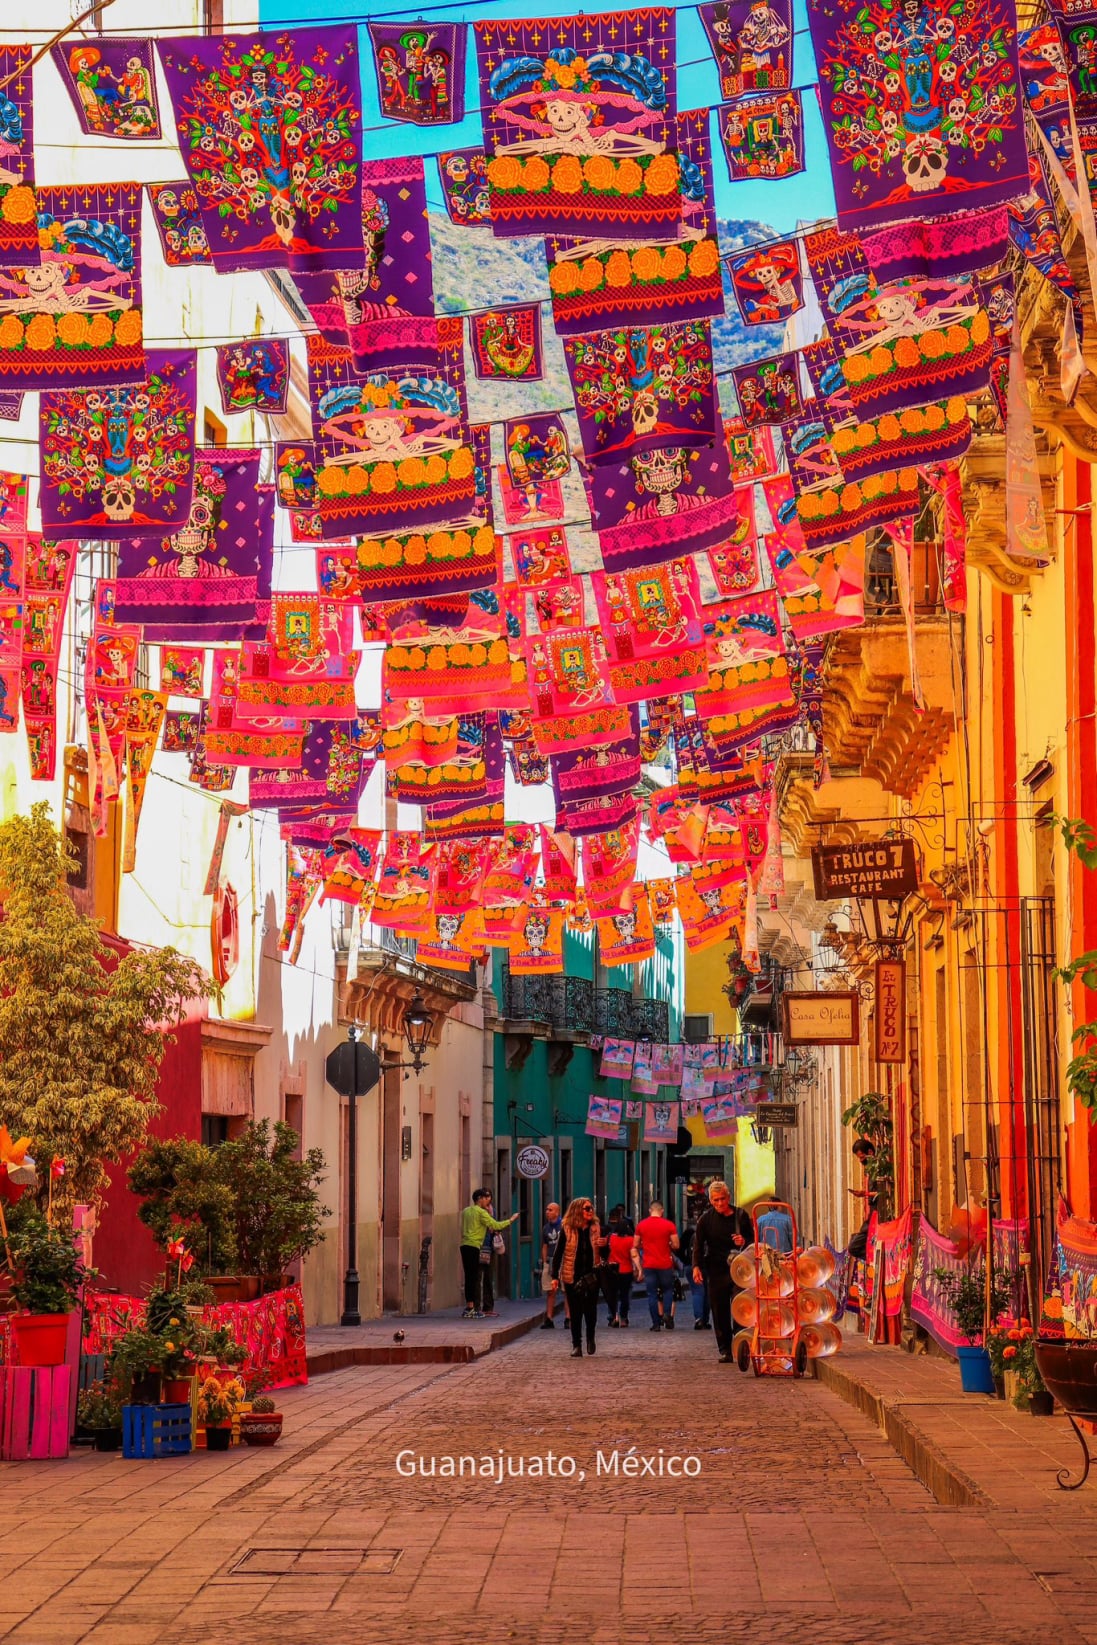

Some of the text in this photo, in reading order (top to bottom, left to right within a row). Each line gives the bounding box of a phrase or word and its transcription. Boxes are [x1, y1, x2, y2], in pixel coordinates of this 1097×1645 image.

[832, 846, 904, 870] TRUCO 7
[830, 869, 904, 885] RESTAURANT
[850, 882, 883, 894] CAFE
[790, 1006, 850, 1024] Casa Ofelia
[883, 984, 898, 1037] TRUCO
